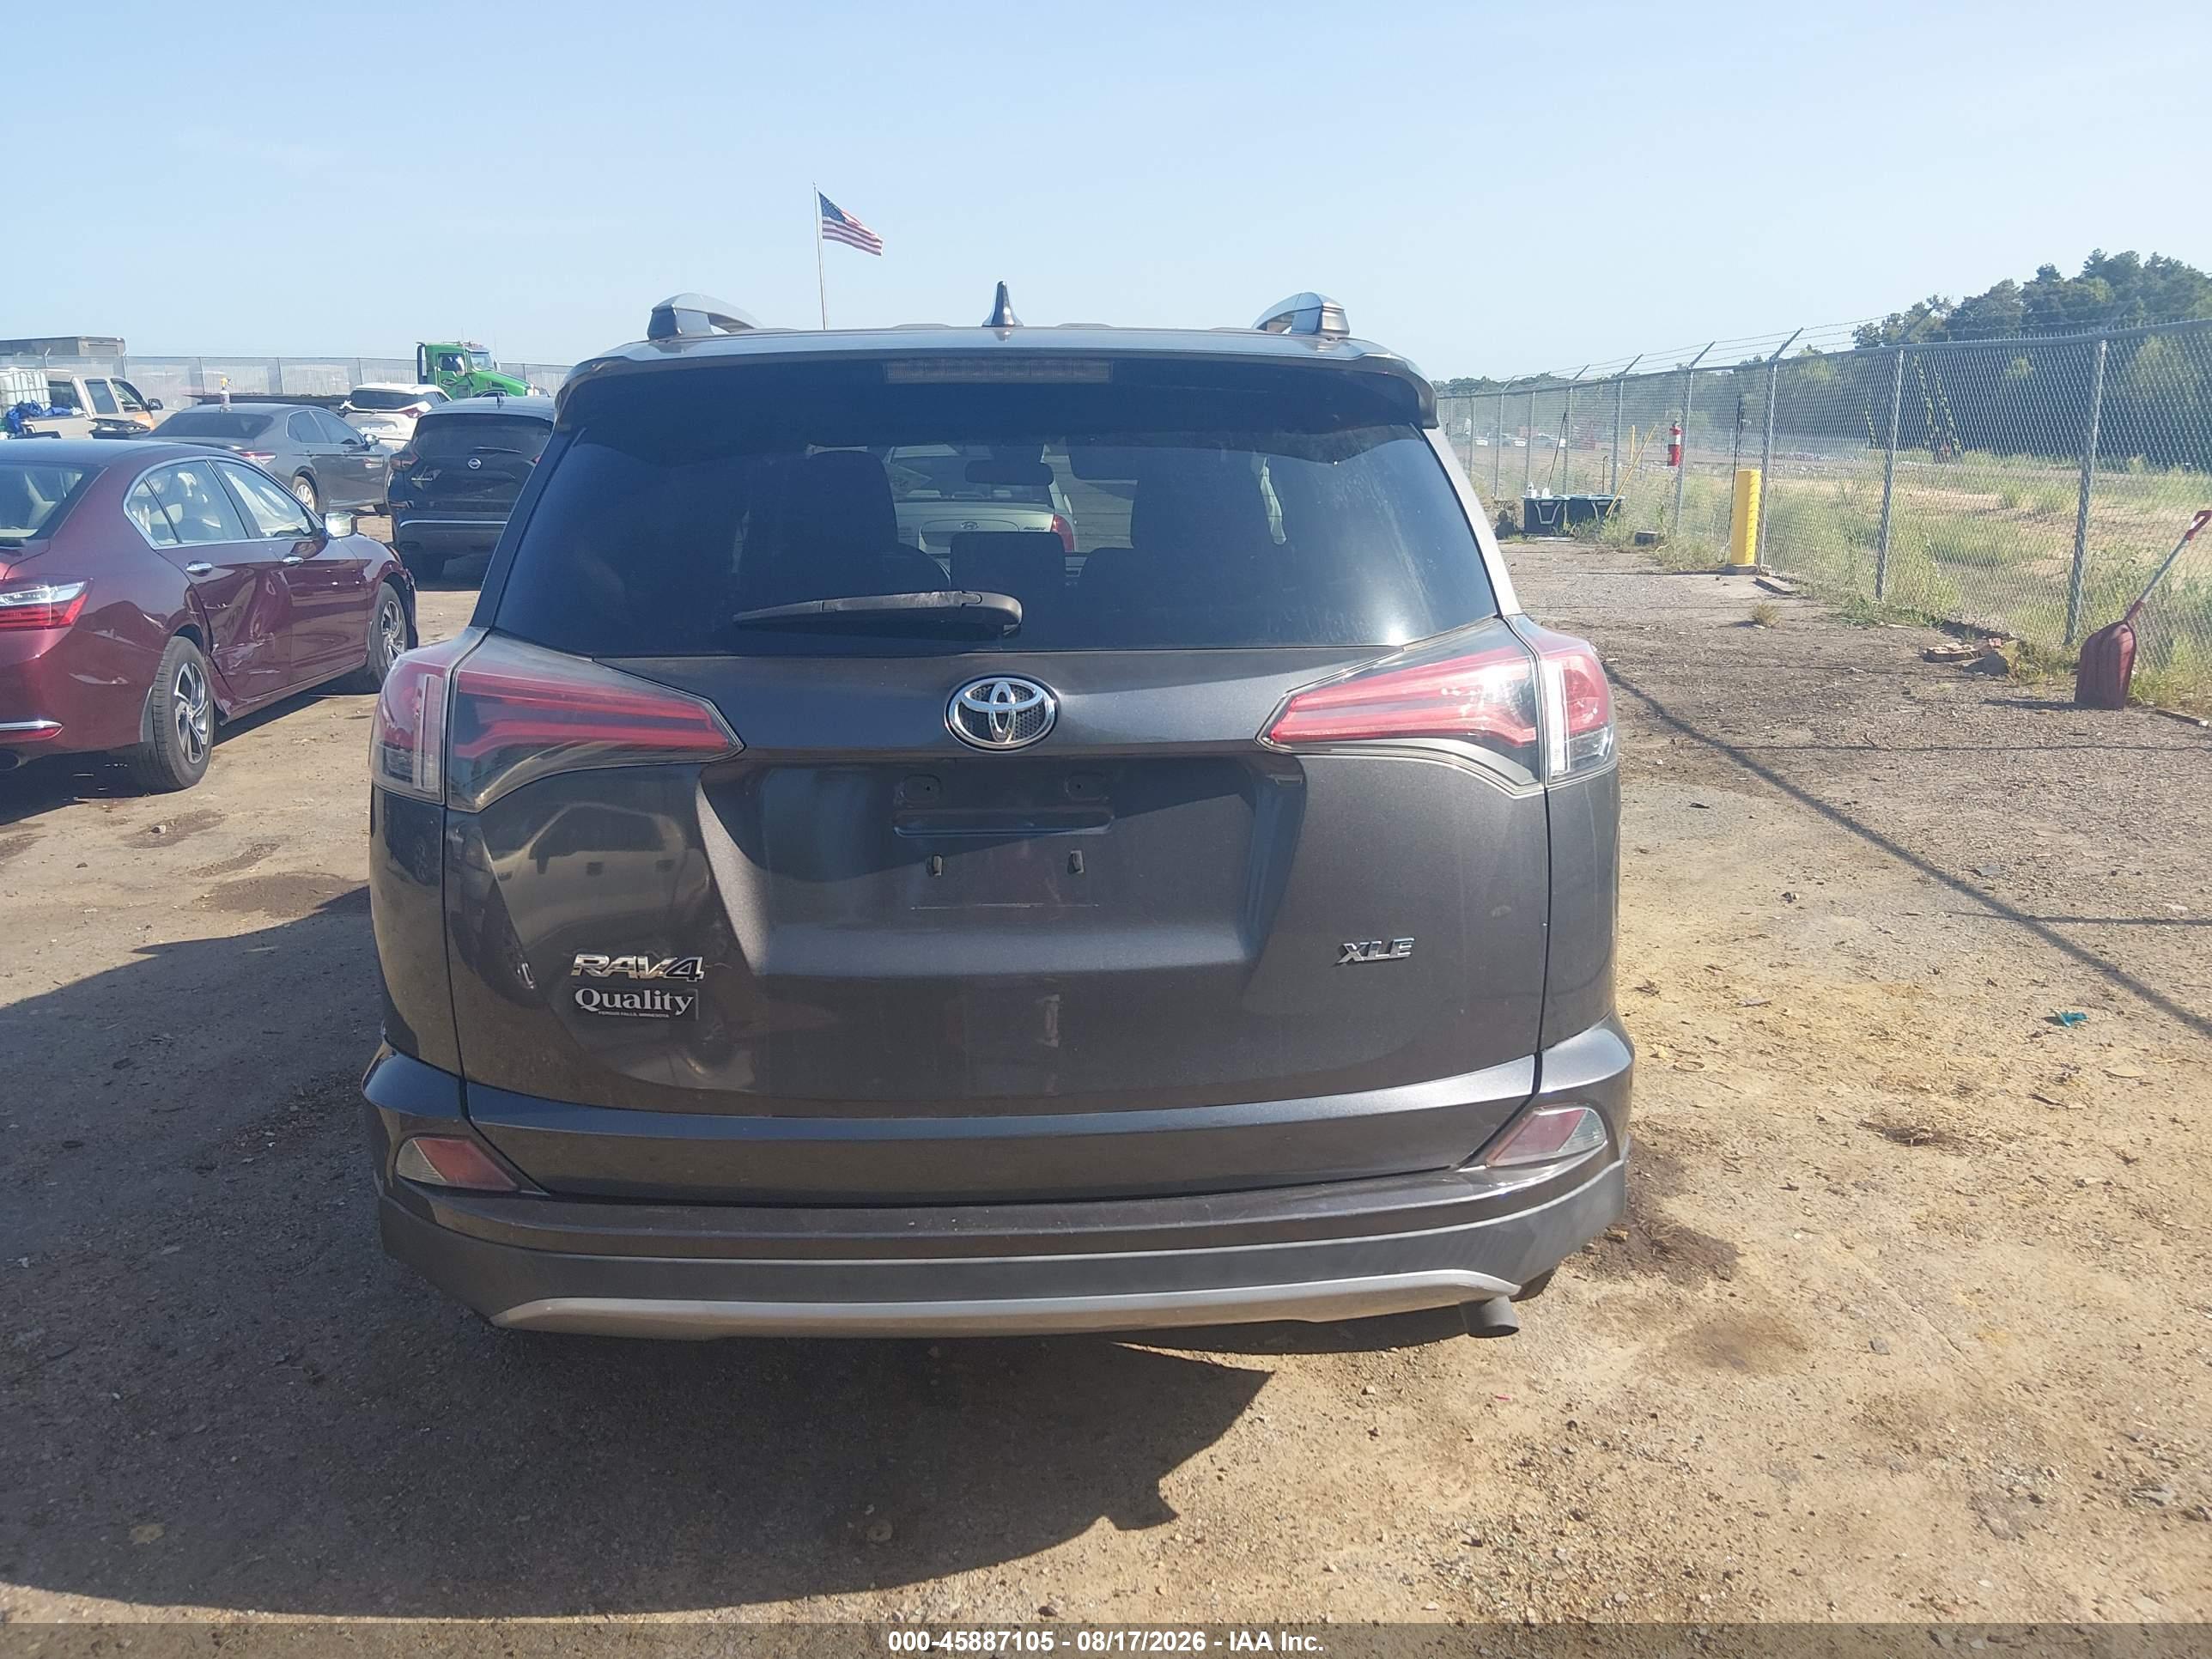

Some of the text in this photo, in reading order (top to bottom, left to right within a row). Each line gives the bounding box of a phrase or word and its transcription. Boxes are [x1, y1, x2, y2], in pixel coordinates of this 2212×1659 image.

[1337, 937, 1415, 963] XLE
[570, 953, 705, 982] RAV4
[574, 988, 694, 1016] Quality
